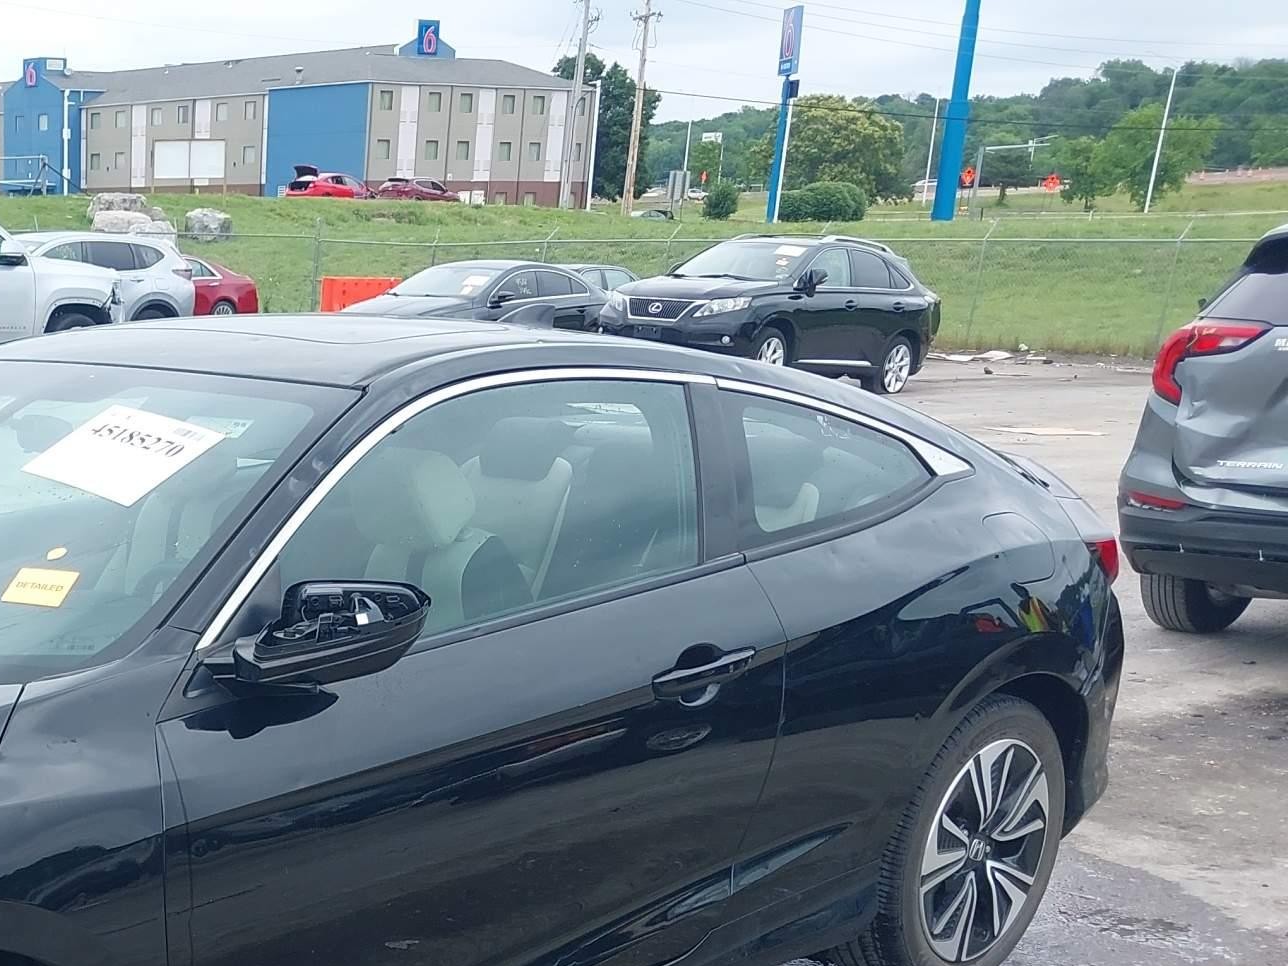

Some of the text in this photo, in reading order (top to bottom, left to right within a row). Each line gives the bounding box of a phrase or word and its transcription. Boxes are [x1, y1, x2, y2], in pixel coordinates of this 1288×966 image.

[423, 26, 437, 53] 6
[783, 9, 795, 58] 6
[25, 62, 36, 85] 6
[92, 424, 184, 457] 45185270
[1217, 460, 1283, 469] TERRAIN
[16, 582, 64, 591] DETAILED
